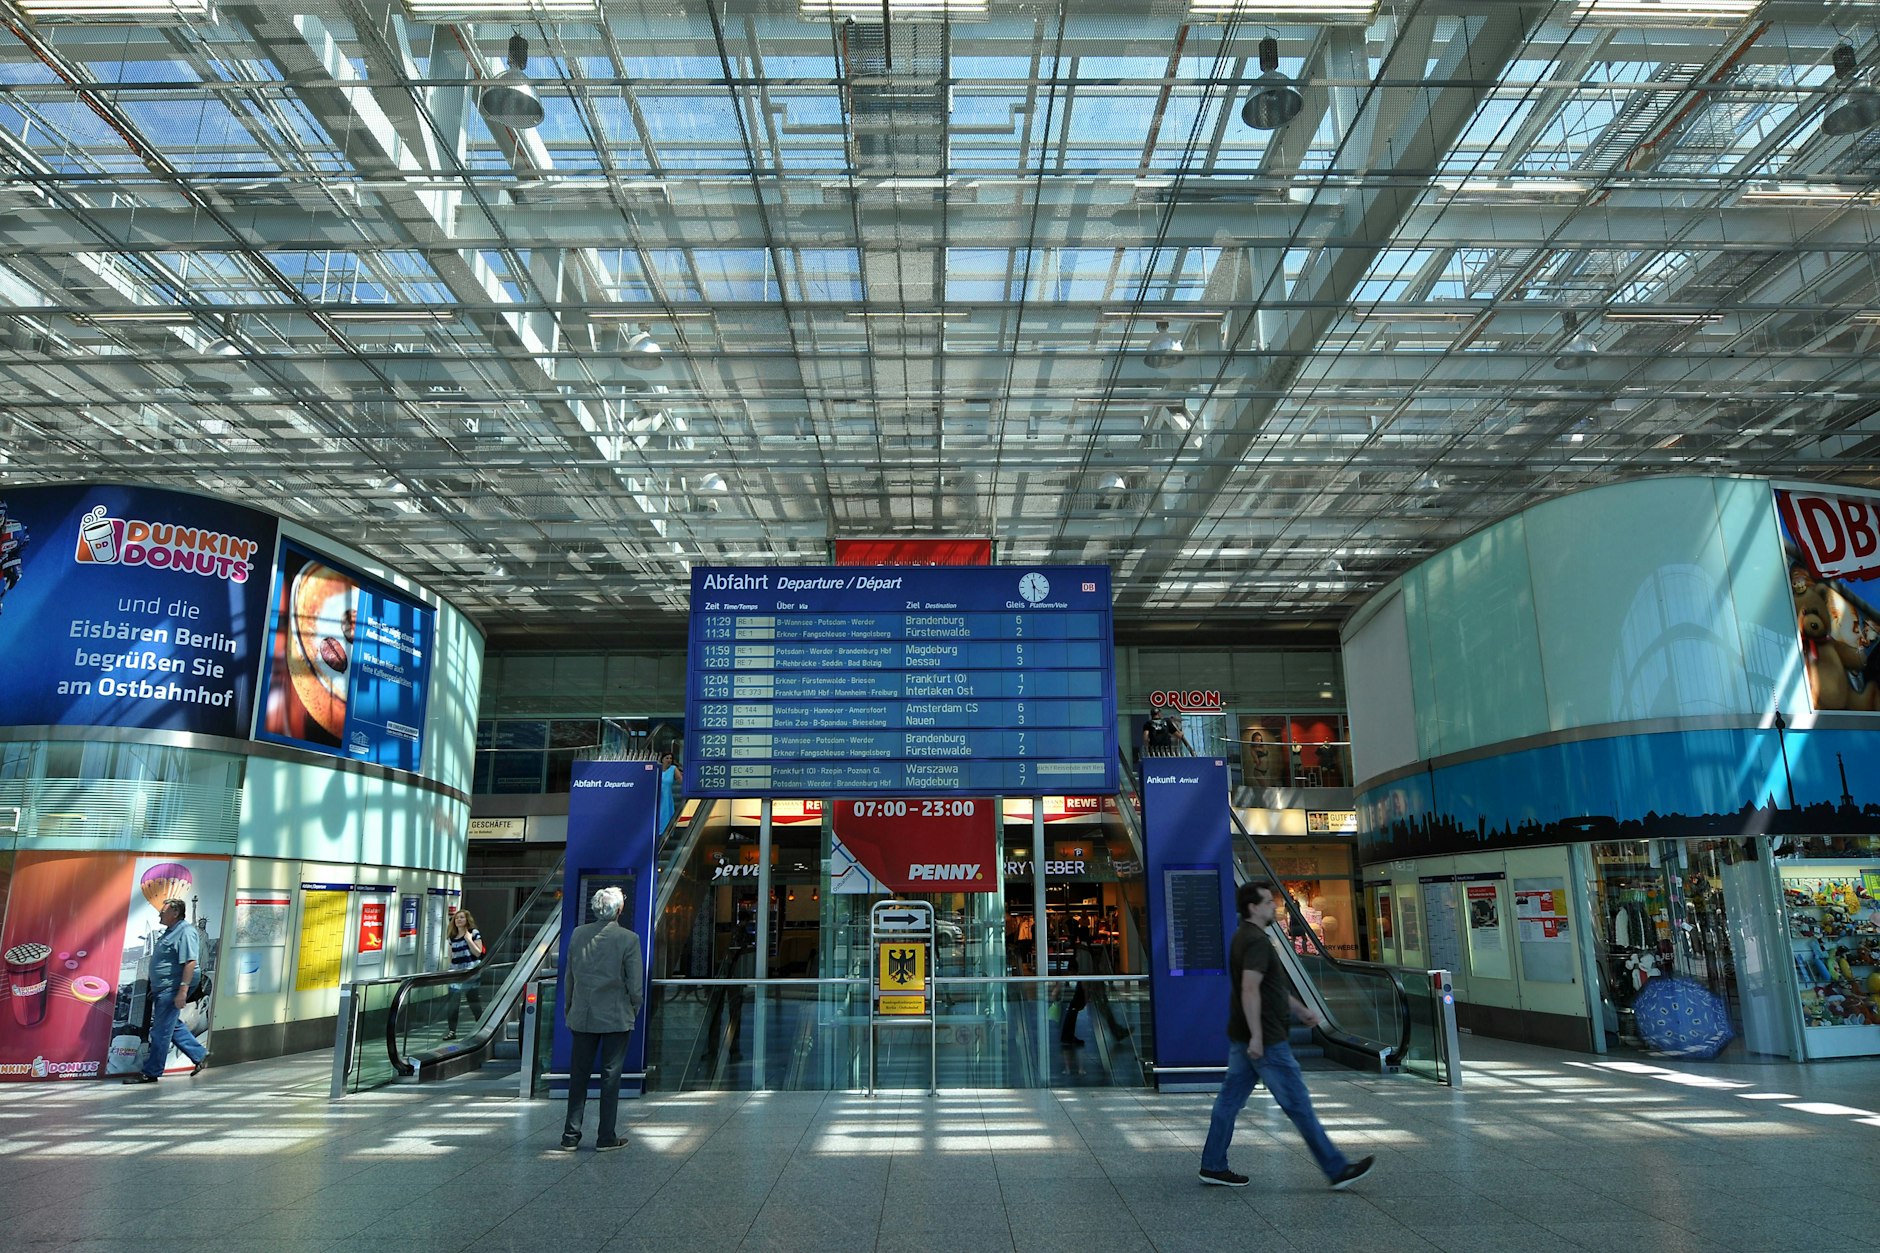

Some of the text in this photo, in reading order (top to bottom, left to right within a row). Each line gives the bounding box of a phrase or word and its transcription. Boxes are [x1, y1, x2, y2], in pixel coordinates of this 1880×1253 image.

[127, 522, 258, 557] DUNKIN'
[124, 543, 252, 584] DONUTS
[703, 574, 902, 591] Abfahrt Departure Départ
[1083, 583, 1095, 591] DB
[118, 597, 200, 620] und die
[705, 602, 720, 610] Zeit
[777, 602, 794, 610] Über
[906, 601, 920, 609] Ziel
[1006, 601, 1025, 609] Gleis
[706, 617, 731, 626] 11:29
[906, 616, 964, 626] Brandenburg
[1016, 616, 1021, 624] 6
[70, 620, 236, 653] Eisbären Berlin
[705, 629, 730, 638] 11:34
[906, 628, 970, 637] Fürstenwalde
[1016, 628, 1022, 636] 2
[705, 646, 730, 655] 11:59
[906, 646, 958, 656] Magdeburg
[1017, 645, 1022, 654] 6
[75, 649, 224, 678] begrüßen Sie
[704, 658, 730, 667] 12:03
[906, 657, 940, 666] Dessau
[1017, 657, 1023, 665] 3
[704, 675, 729, 685] 12:04
[906, 674, 951, 683] Frankfurt
[955, 674, 966, 684] (O)
[1019, 674, 1023, 683] 1
[57, 678, 233, 707] am Ostbahnhof
[703, 687, 729, 697] 12:19
[905, 686, 953, 695] Interlaken
[957, 686, 974, 695] Ost
[1018, 686, 1023, 695] 7
[1150, 690, 1221, 712] ORION
[703, 705, 728, 715] 12:23
[906, 704, 962, 713] Amsterdam
[966, 704, 978, 713] CS
[1018, 704, 1024, 712] 6
[702, 718, 727, 727] 12:26
[906, 716, 935, 725] Nauen
[1018, 716, 1024, 725] 3
[702, 735, 726, 745] 12:29
[906, 734, 965, 745] Brandenburg
[1019, 734, 1024, 742] 7
[701, 748, 726, 757] 12:34
[906, 746, 972, 756] Fürstenwalde
[1019, 746, 1025, 755] 2
[700, 766, 726, 775] 12:50
[906, 764, 958, 774] Warszawa
[1019, 764, 1025, 773] 3
[573, 780, 634, 789] Abfahrt Departure
[699, 779, 725, 788] 12:59
[906, 776, 959, 788] Magdeburg
[1020, 777, 1025, 785] 7
[1147, 776, 1176, 784] Ankunft
[1067, 798, 1097, 808] REWE
[854, 801, 974, 817] 07:00 23:00
[833, 868, 856, 892] Ostbahnhof
[0, 1061, 100, 1074] NKIN' DONUTS
